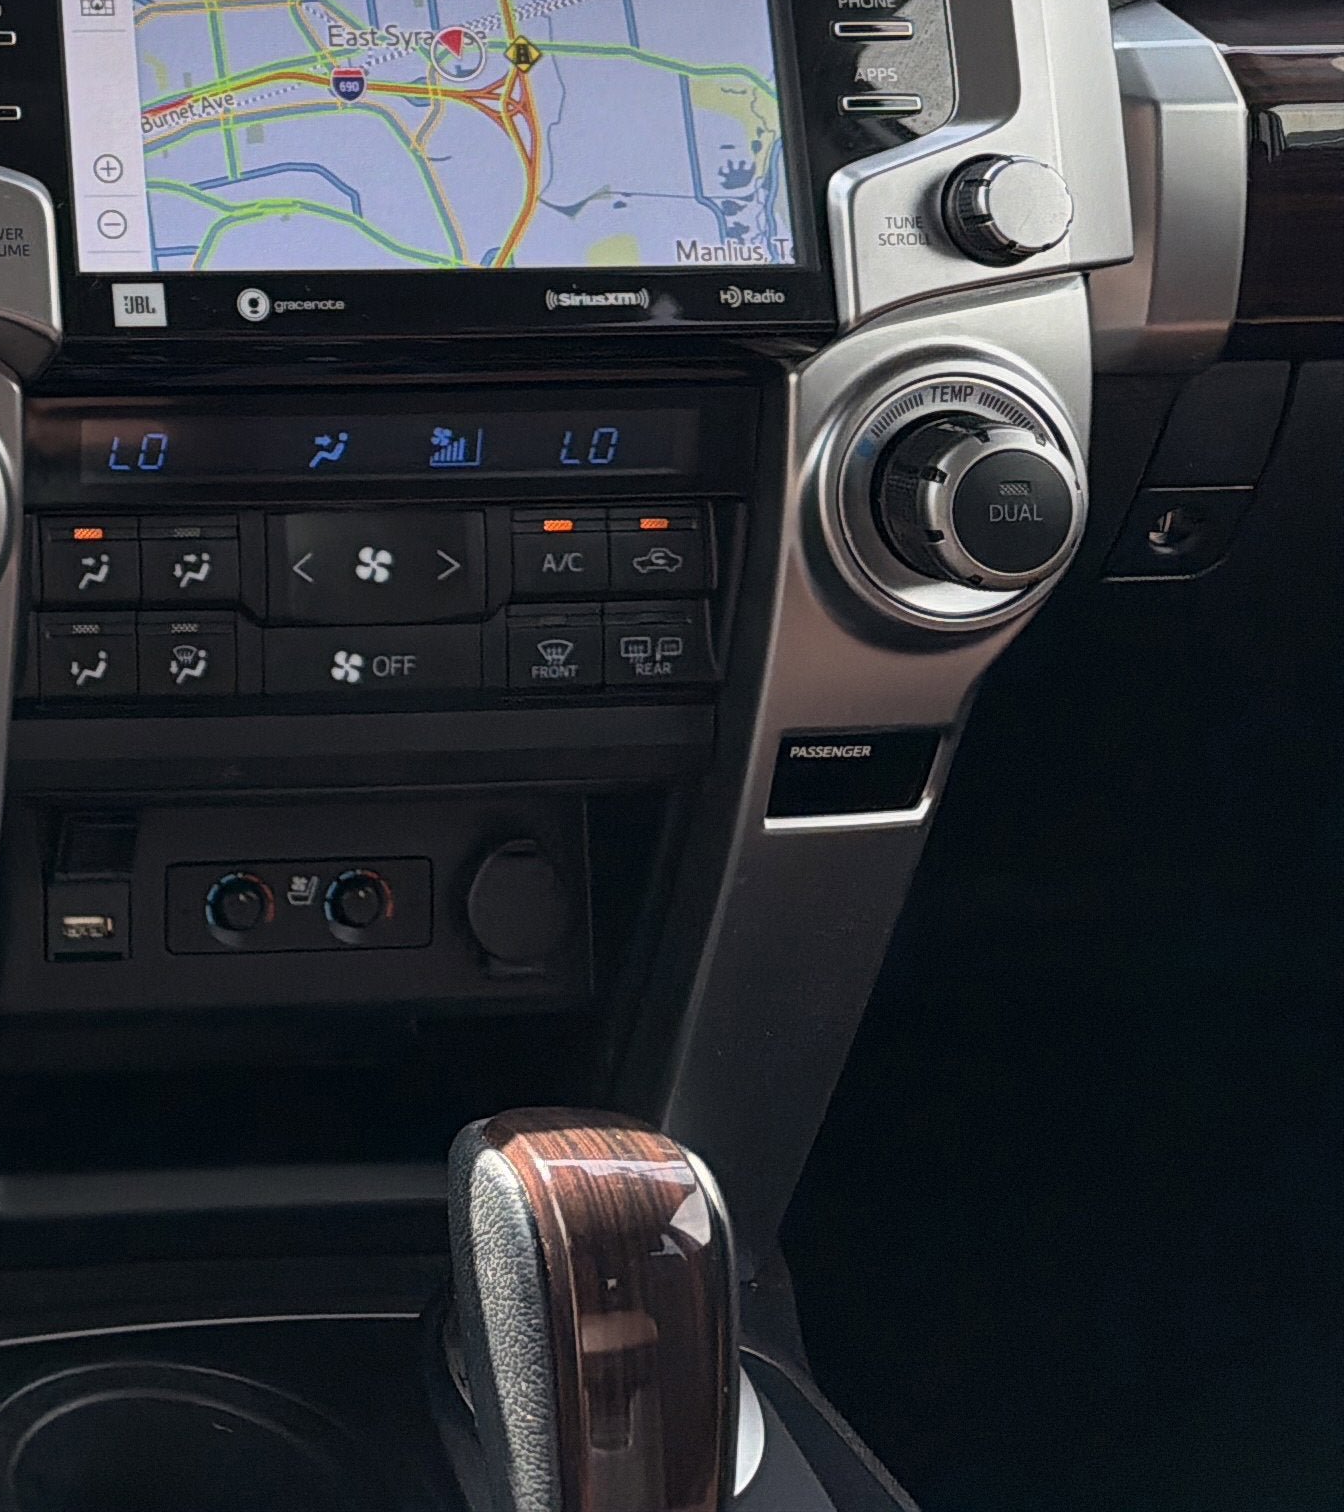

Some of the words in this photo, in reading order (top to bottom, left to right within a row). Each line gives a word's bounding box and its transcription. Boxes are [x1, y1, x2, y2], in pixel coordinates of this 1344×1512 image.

[328, 25, 378, 48] East
[854, 67, 898, 82] APPS
[339, 80, 360, 93] 690
[141, 102, 196, 135] Burnet
[201, 91, 235, 117] Ave
[884, 216, 923, 230] TUNE
[878, 232, 931, 246] SCROLL
[676, 239, 768, 263] Manlius,
[123, 295, 156, 314] JBL
[744, 289, 785, 304] Radio
[274, 299, 345, 313] gracenote
[929, 385, 975, 403] TEMP
[109, 433, 168, 470] LO
[560, 427, 618, 464] LO
[989, 504, 1044, 522] DUAL
[542, 553, 584, 573] A/C
[372, 656, 416, 676] OFF
[531, 664, 578, 678] FRONT
[635, 662, 672, 676] REAR
[789, 745, 872, 759] PASSENGER
